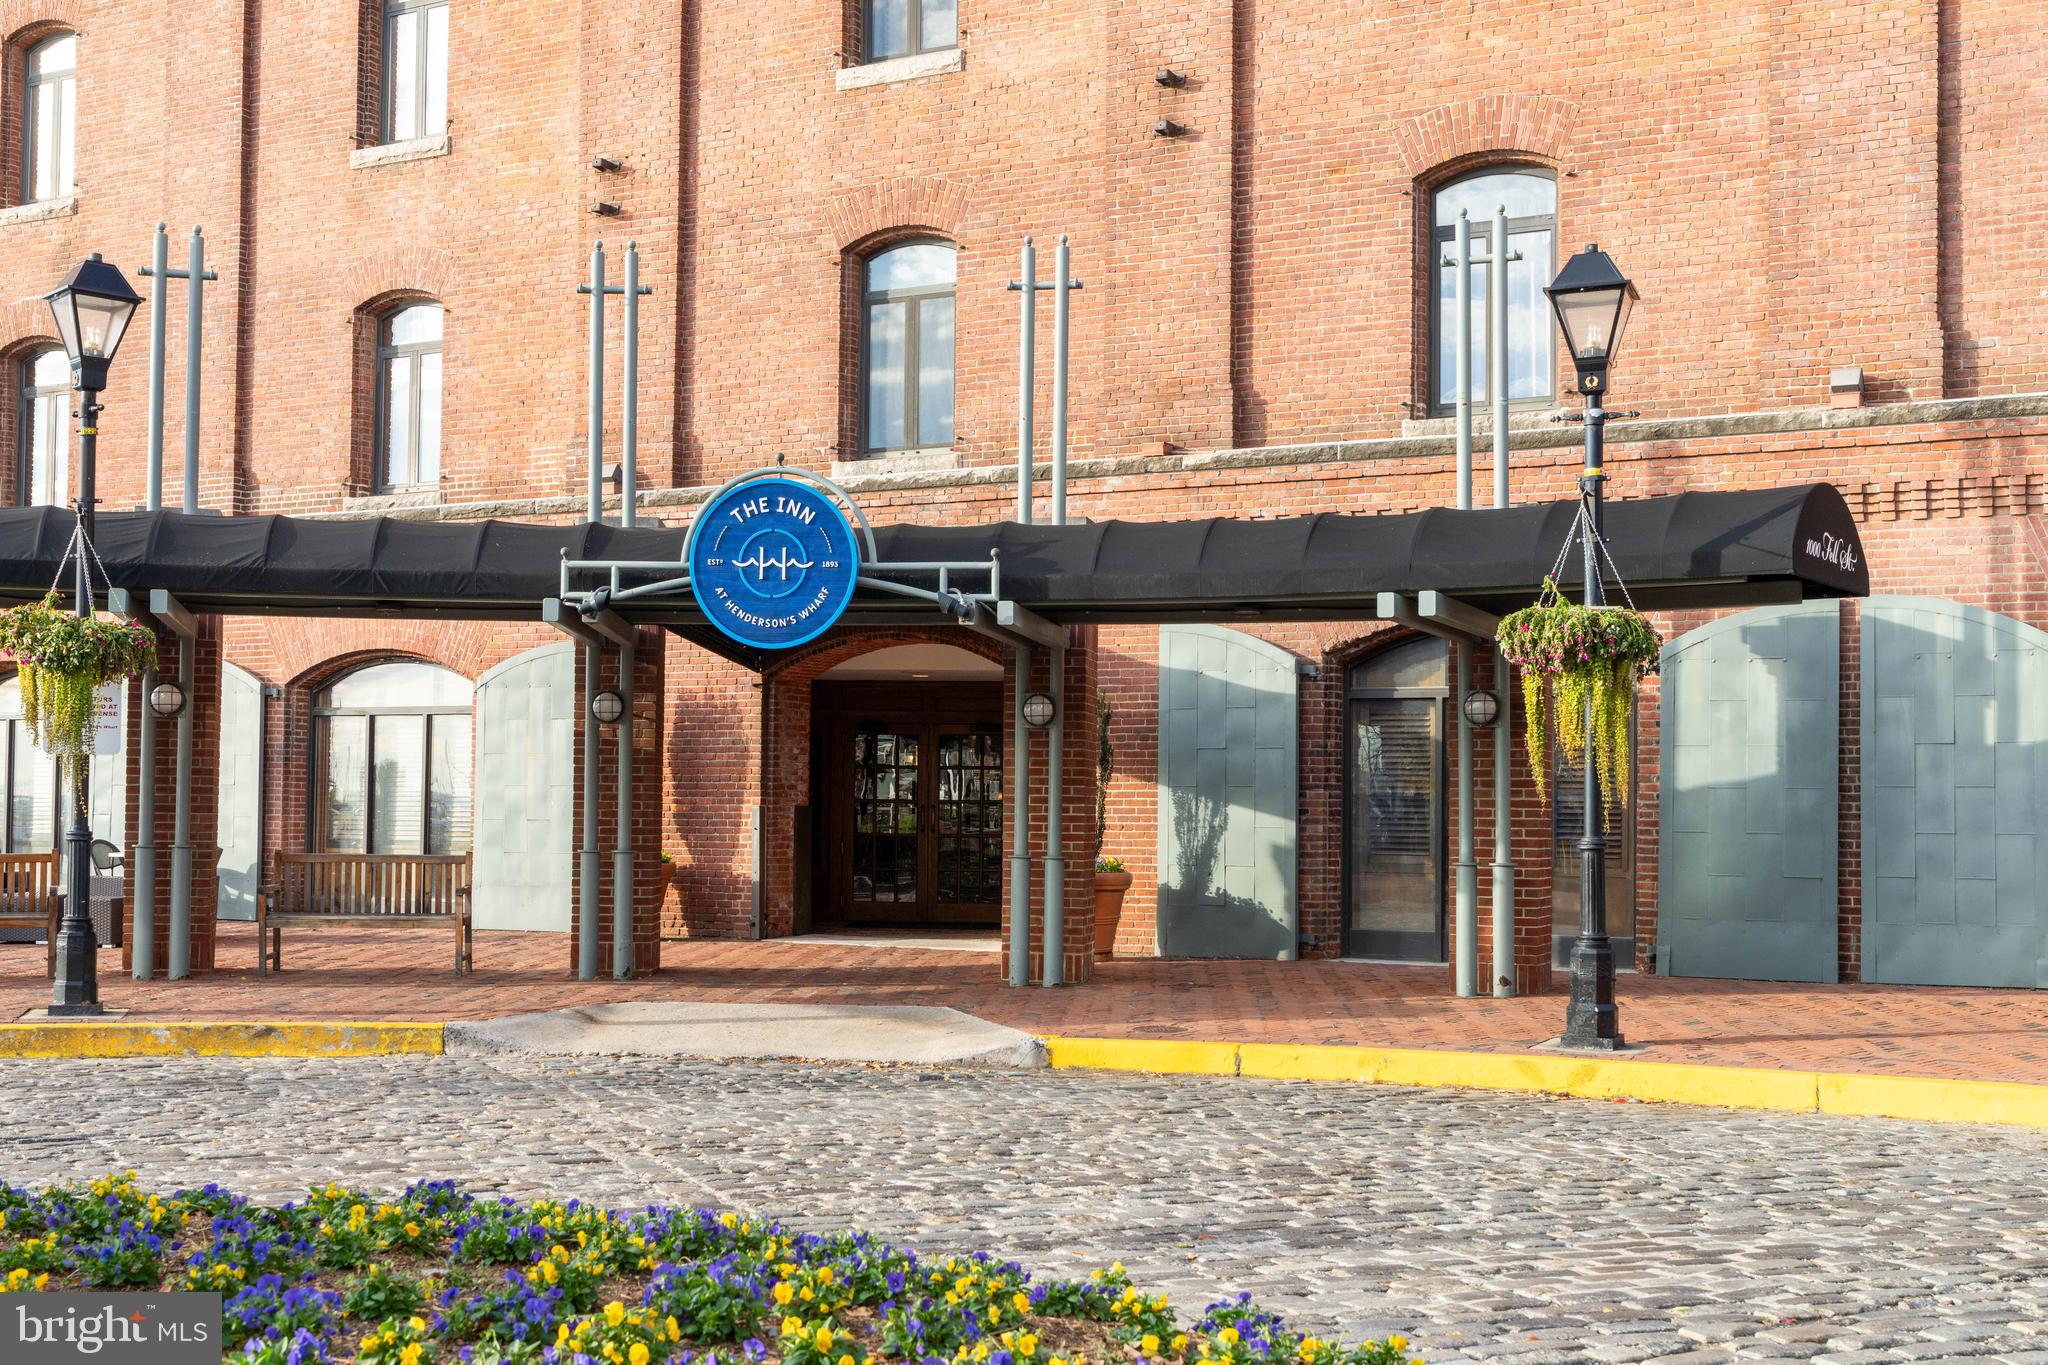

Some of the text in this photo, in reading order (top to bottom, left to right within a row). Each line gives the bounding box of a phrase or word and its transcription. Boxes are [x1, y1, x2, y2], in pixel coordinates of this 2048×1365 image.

[729, 496, 816, 525] THE INN
[1806, 538, 1822, 558] 1000
[822, 560, 839, 568] 1893
[715, 586, 830, 628] AT HENDERSON'S WHARF
